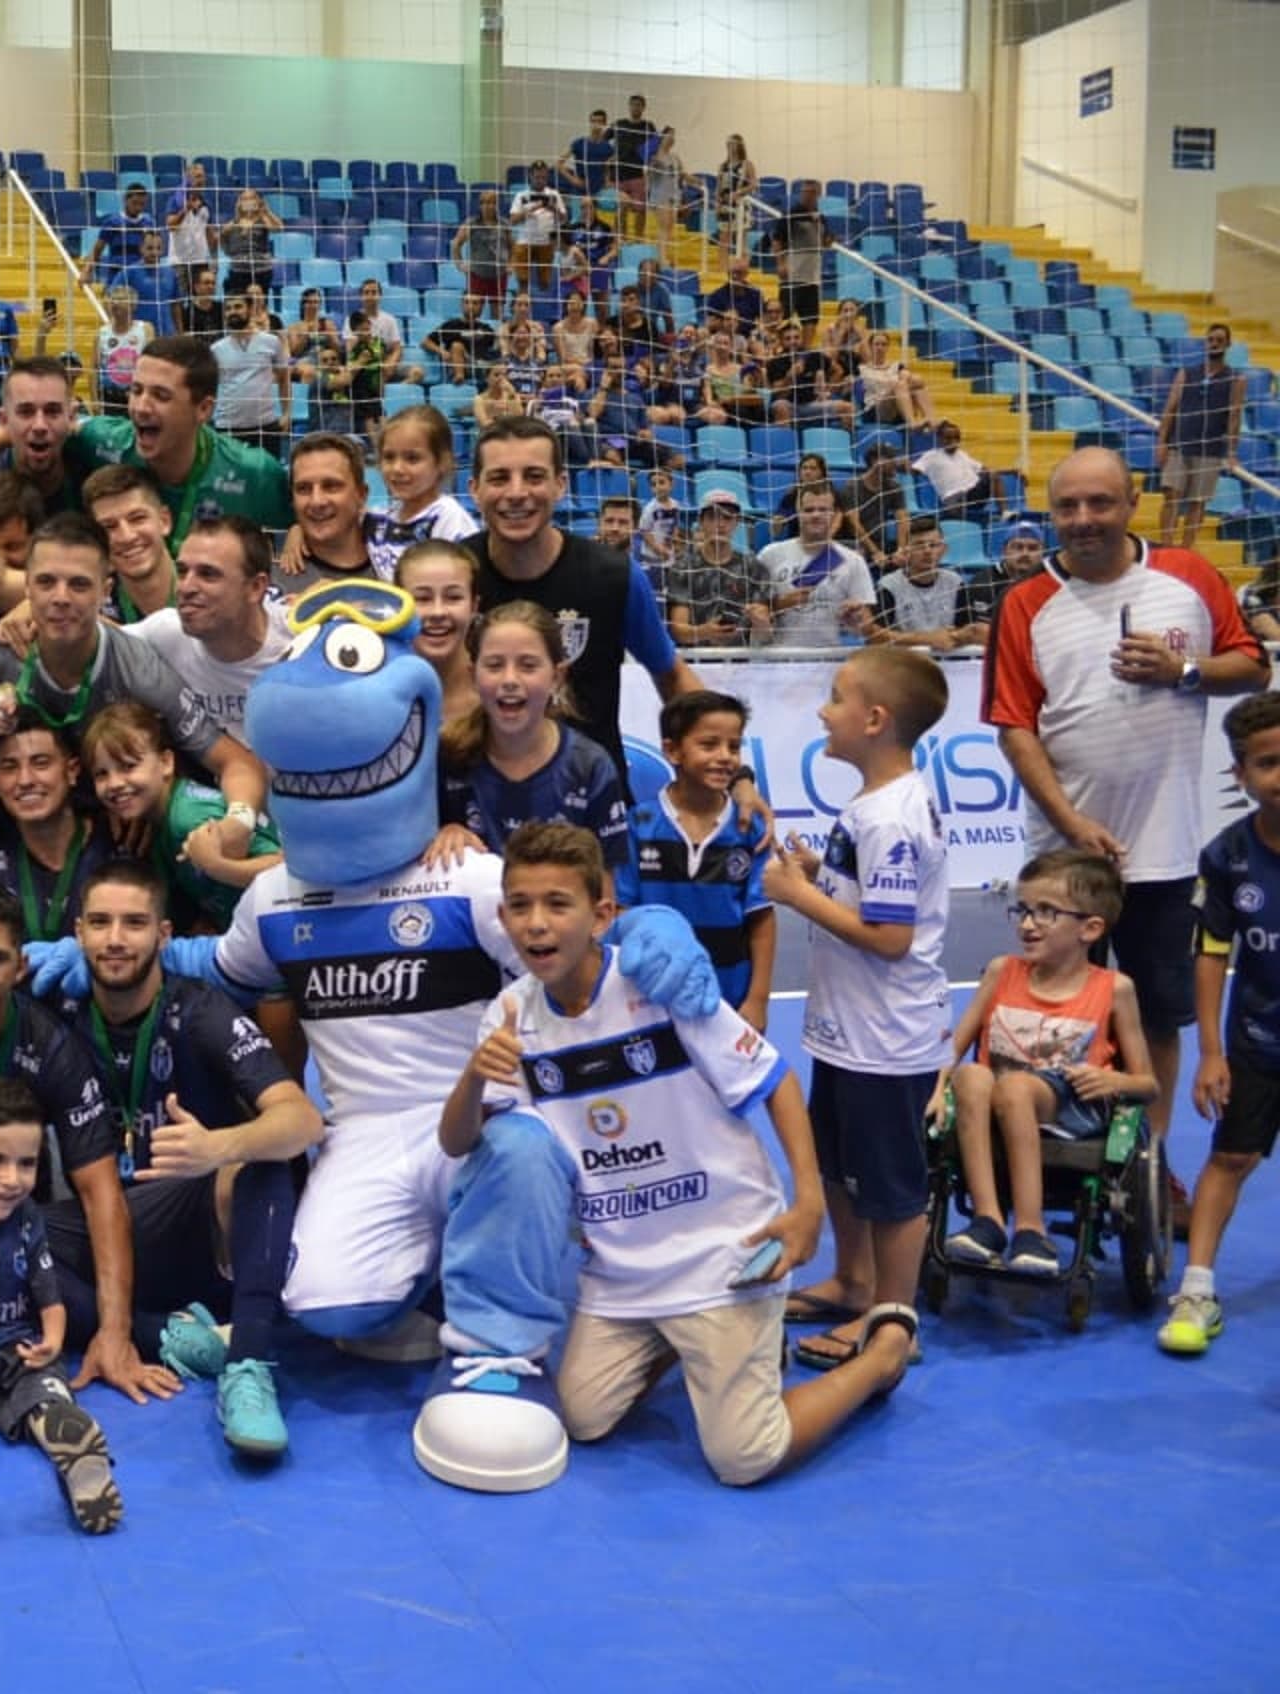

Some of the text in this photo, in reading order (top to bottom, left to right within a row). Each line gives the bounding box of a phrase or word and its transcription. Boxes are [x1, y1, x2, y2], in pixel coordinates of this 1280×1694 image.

[379, 881, 450, 898] RENAULT
[305, 958, 428, 1001] Althoff
[582, 1140, 665, 1171] Dehon
